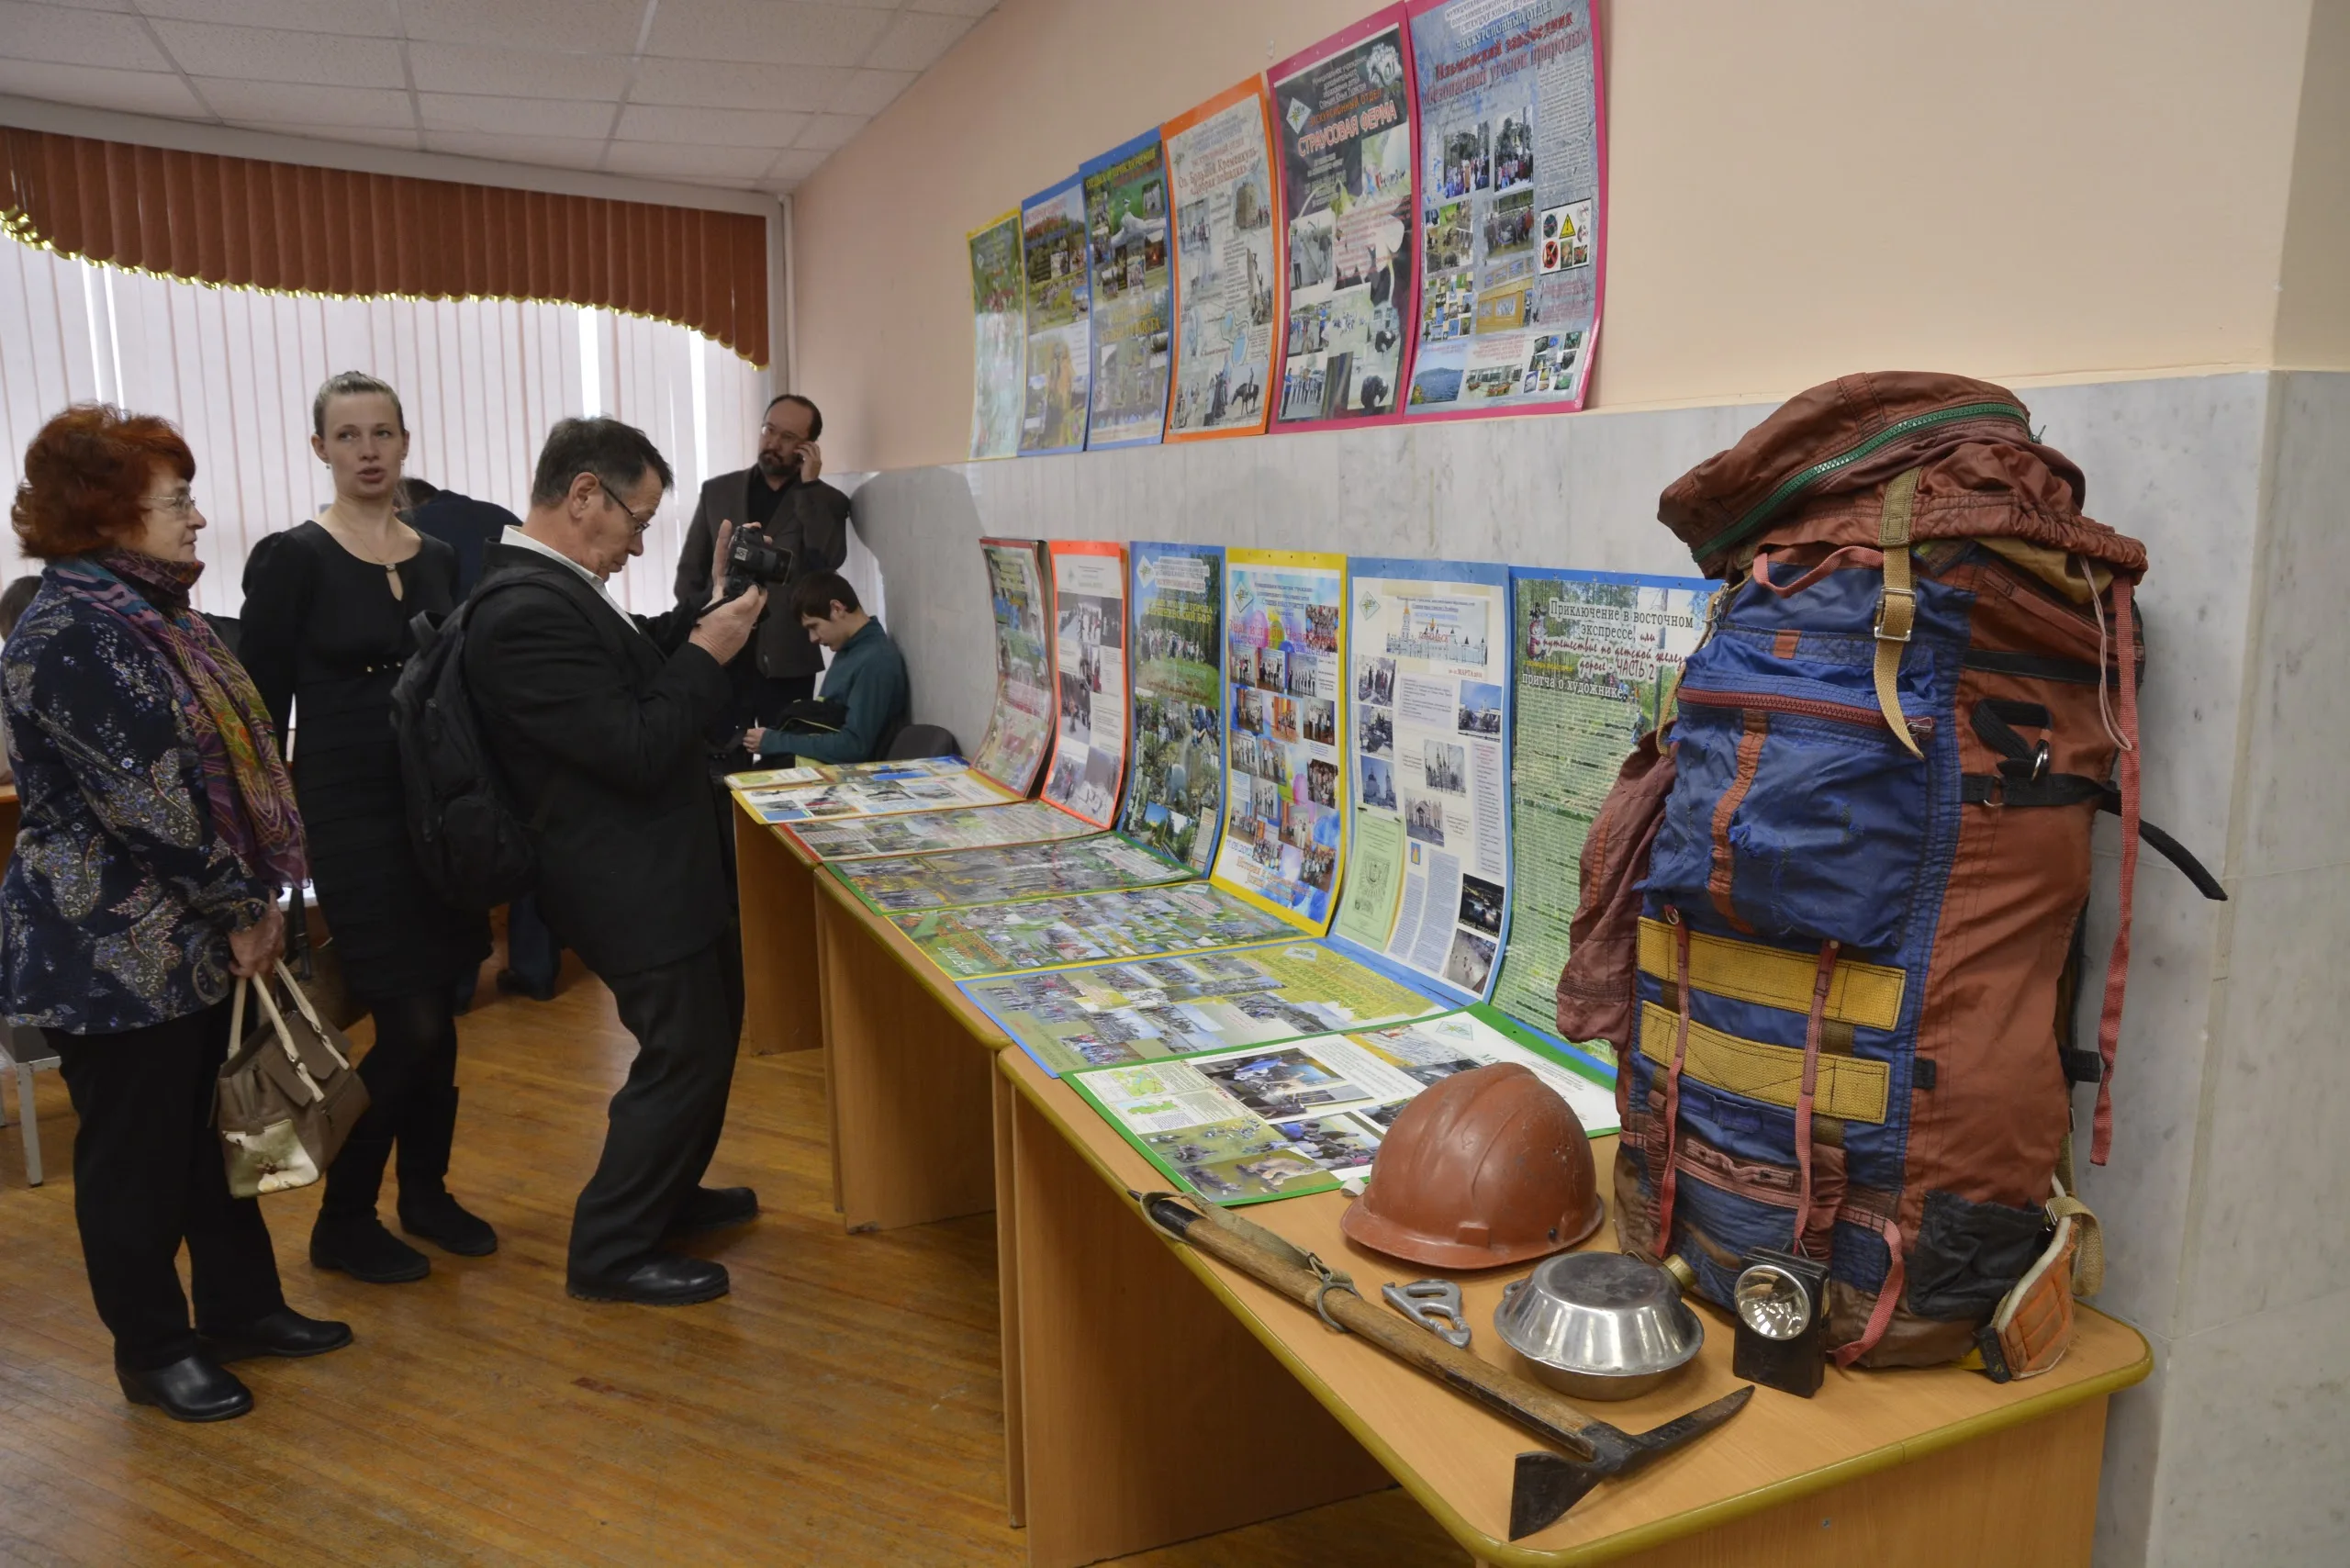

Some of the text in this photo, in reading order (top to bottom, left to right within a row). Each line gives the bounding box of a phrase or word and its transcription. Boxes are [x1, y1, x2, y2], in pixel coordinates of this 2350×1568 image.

[1527, 2, 1552, 23] ОТДЕЛ
[1435, 39, 1502, 81] Ильменский
[1360, 89, 1382, 105] ОТДЕЛ
[1297, 115, 1360, 157] СТРАУСОВАЯ
[1360, 99, 1398, 132] ФЕРМА
[1197, 612, 1212, 623] БОР
[1551, 600, 1694, 628] Приключение в восточном
[1640, 632, 1656, 642] или
[1580, 660, 1606, 675] дороге
[1617, 657, 1645, 678] ЧАСТЬ
[1649, 663, 1654, 680] 2
[1601, 645, 1611, 655] по
[1615, 647, 1651, 662] детской
[1655, 653, 1686, 671] желез
[1522, 673, 1628, 701] притча о художнике.
